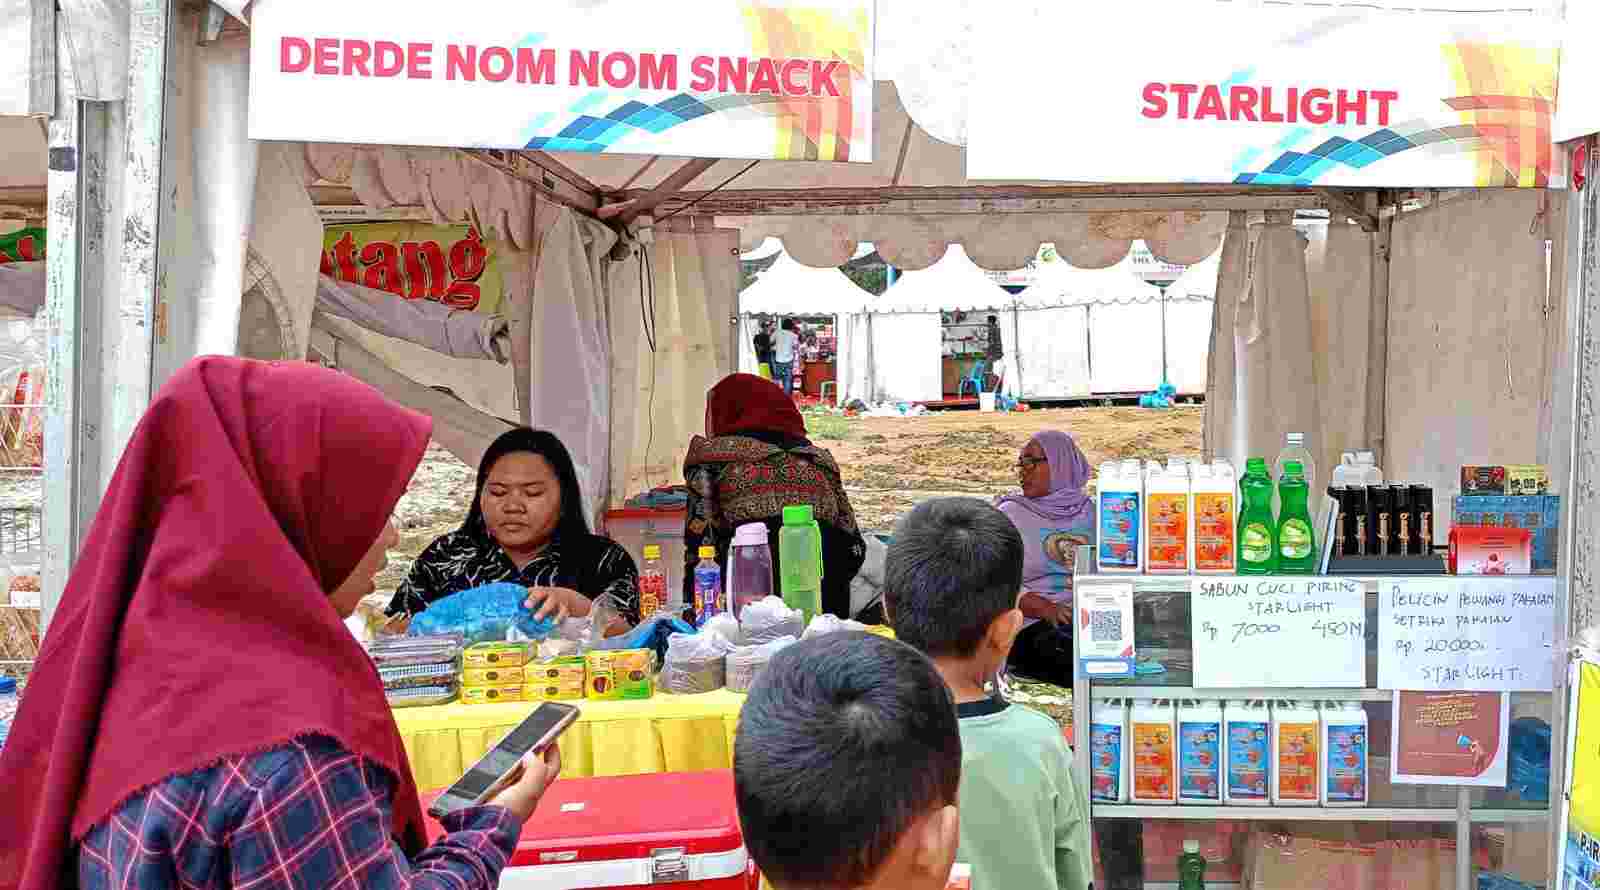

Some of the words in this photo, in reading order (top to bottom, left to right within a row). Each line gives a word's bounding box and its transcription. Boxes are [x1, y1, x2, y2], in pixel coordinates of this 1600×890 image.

[280, 36, 433, 79] DERDE
[446, 44, 556, 85] NOM
[568, 49, 678, 91] NOM
[689, 55, 841, 97] SNACK
[1140, 82, 1399, 127] STARLIGHT
[1199, 582, 1249, 598] SABUN
